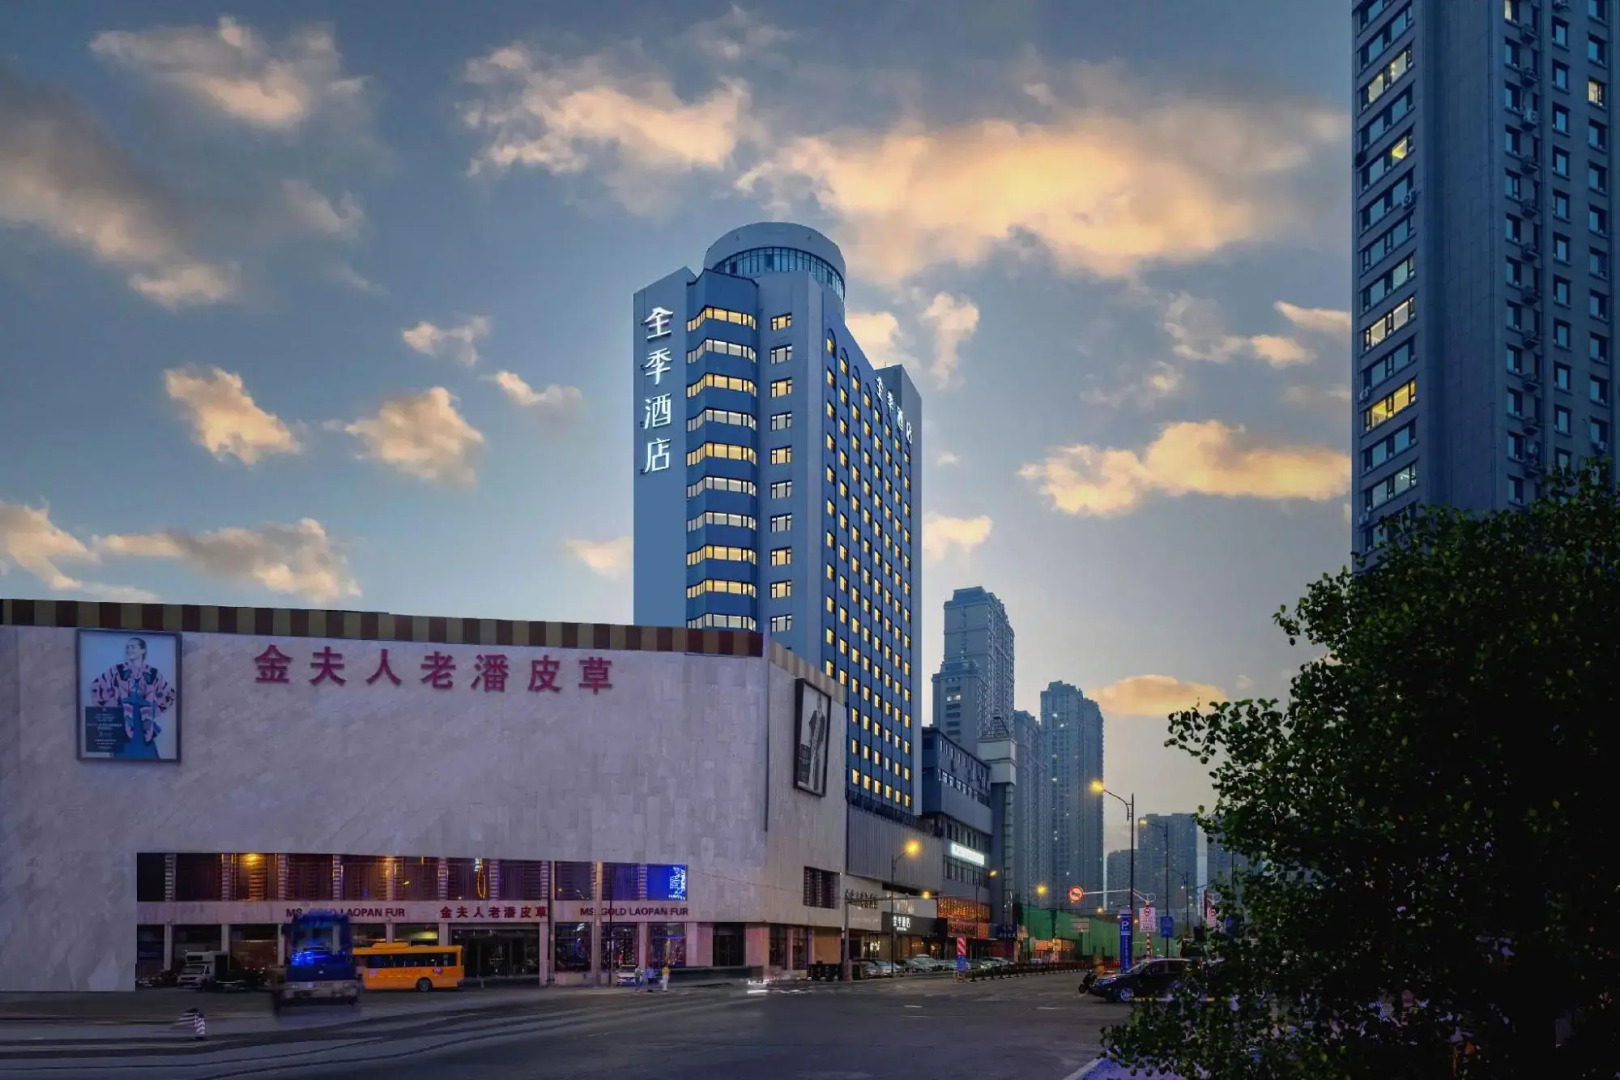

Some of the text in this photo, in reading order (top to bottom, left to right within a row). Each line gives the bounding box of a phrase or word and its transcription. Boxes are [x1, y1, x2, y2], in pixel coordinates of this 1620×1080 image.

[643, 306, 674, 474] 全季酒店
[254, 644, 613, 695] 金夫人老潘皮草
[385, 908, 405, 917] FUR
[440, 905, 547, 918] 金夫人老潘皮草
[601, 908, 627, 916] GOLD
[629, 908, 667, 916] LAOPAN
[670, 908, 688, 916] FUR
[1121, 920, 1130, 931] P
